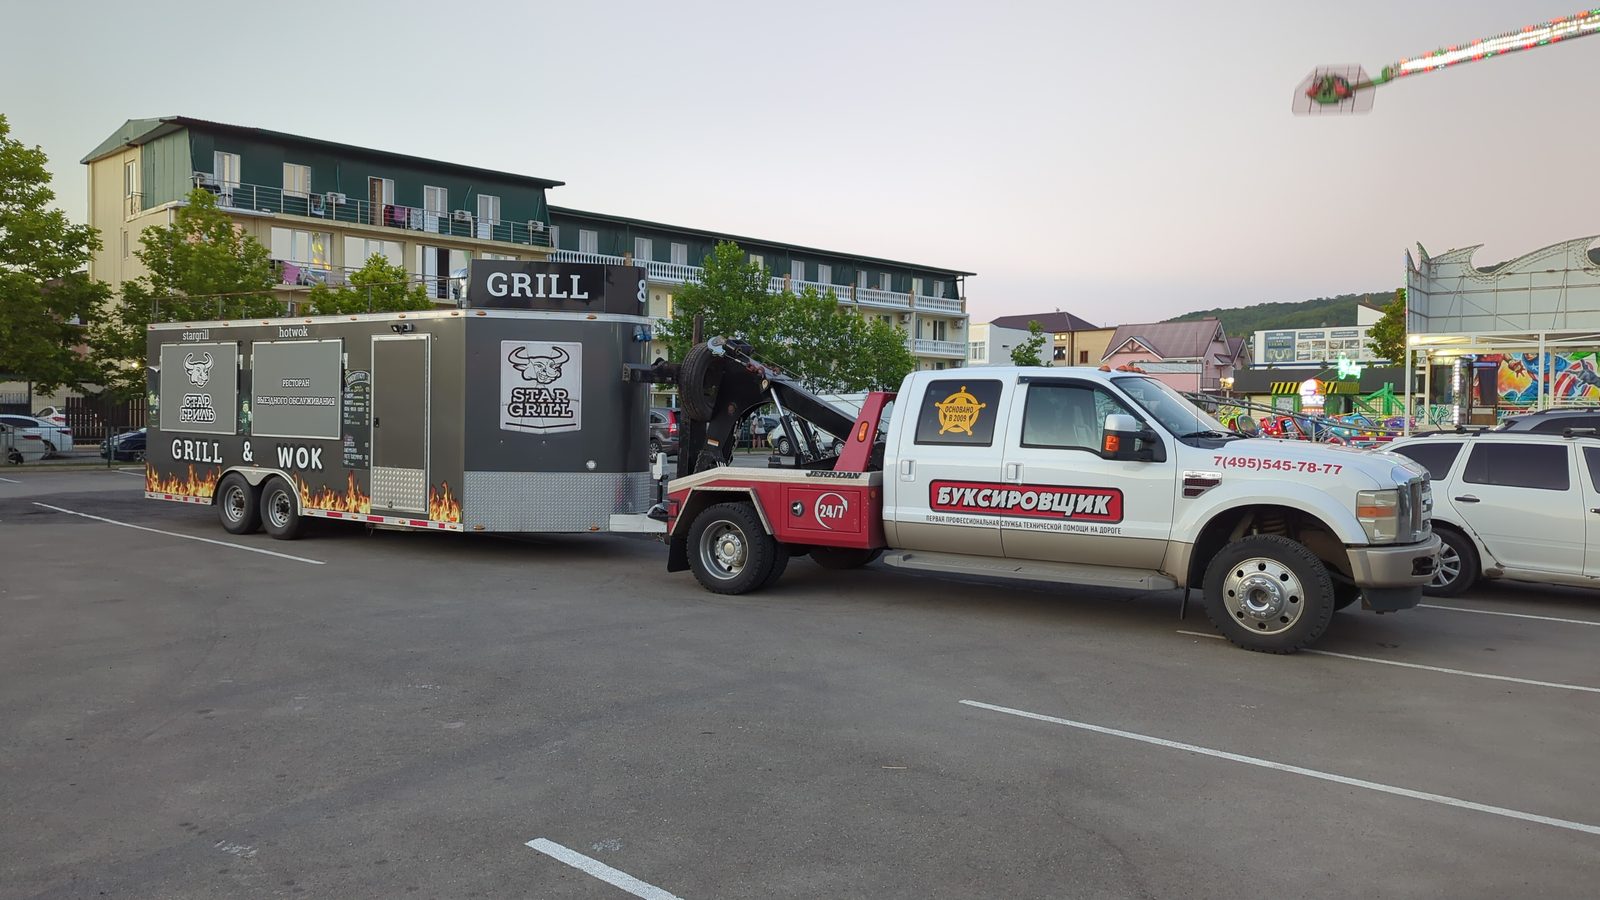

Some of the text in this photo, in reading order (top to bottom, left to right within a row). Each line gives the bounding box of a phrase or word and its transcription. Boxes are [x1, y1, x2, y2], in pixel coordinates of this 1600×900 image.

[486, 272, 588, 299] GRILL
[182, 329, 209, 342] stargrill
[279, 326, 308, 338] hotwok
[282, 379, 310, 387] РЕСТОРАН
[184, 395, 211, 408] СТАР
[257, 396, 288, 406] ВЫЕЗДНОГО
[289, 397, 335, 406] ОБСЛУЖИВАНИЯ
[512, 388, 569, 403] STAR
[181, 408, 215, 422] ГРИЛЬ
[508, 403, 574, 418] GRILL
[945, 405, 974, 413] ОСНОВАНО
[953, 414, 967, 422] 2009
[172, 439, 323, 470] GRILL & WOK
[1213, 455, 1343, 475] 7(495)545-78-77
[937, 487, 1112, 517] БУКСИРОВЩИК
[820, 504, 843, 518] 24/7
[926, 514, 1121, 536] ПЕРВАЯ ПРОФЕССИОНАЛЬНАЯ СЛУЖБА ТЕХНИЧЕСКОЙ ПОМОЩИ НА ДОРОГЕ
